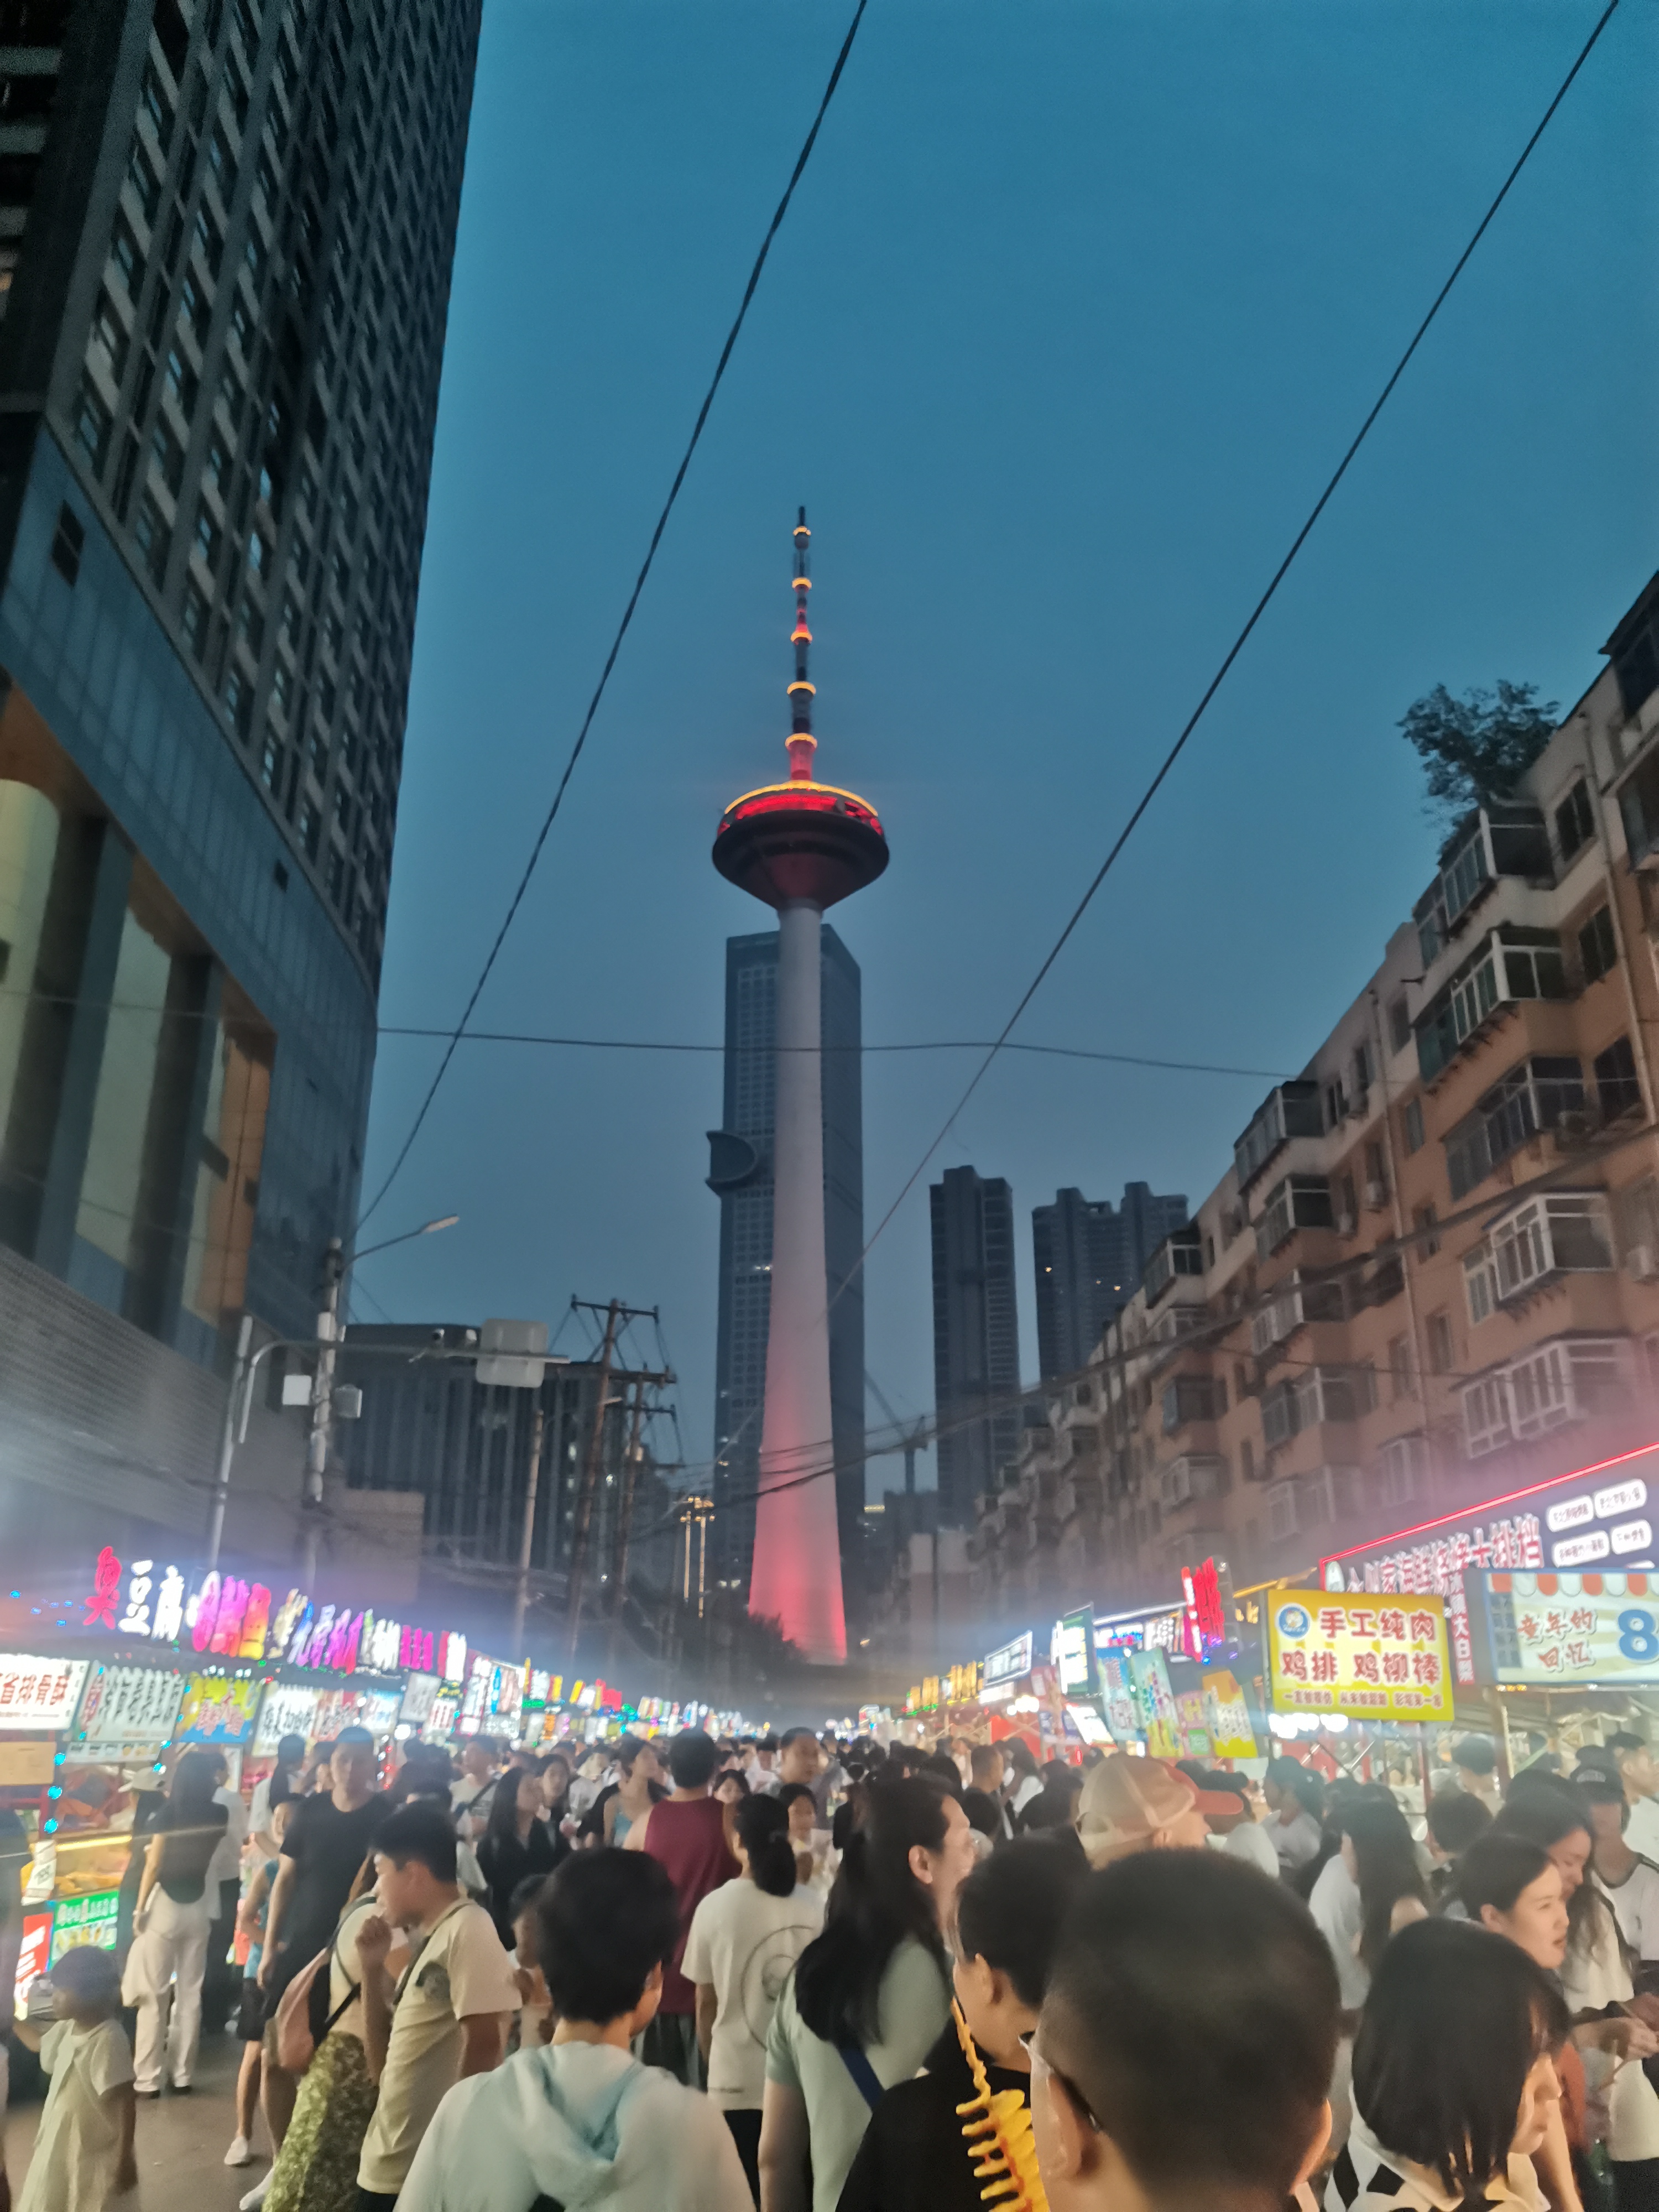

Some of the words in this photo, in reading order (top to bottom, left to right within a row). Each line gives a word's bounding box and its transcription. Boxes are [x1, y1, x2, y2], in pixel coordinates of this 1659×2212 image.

[83, 1546, 185, 1642] 臭豆腐
[1321, 1608, 1436, 1641] 手工纯肉
[1517, 1608, 1592, 1639] 童年的
[1282, 1650, 1338, 1682] 鸡排
[1354, 1651, 1439, 1684] 鸡柳棒
[1538, 1641, 1590, 1667] 回忆
